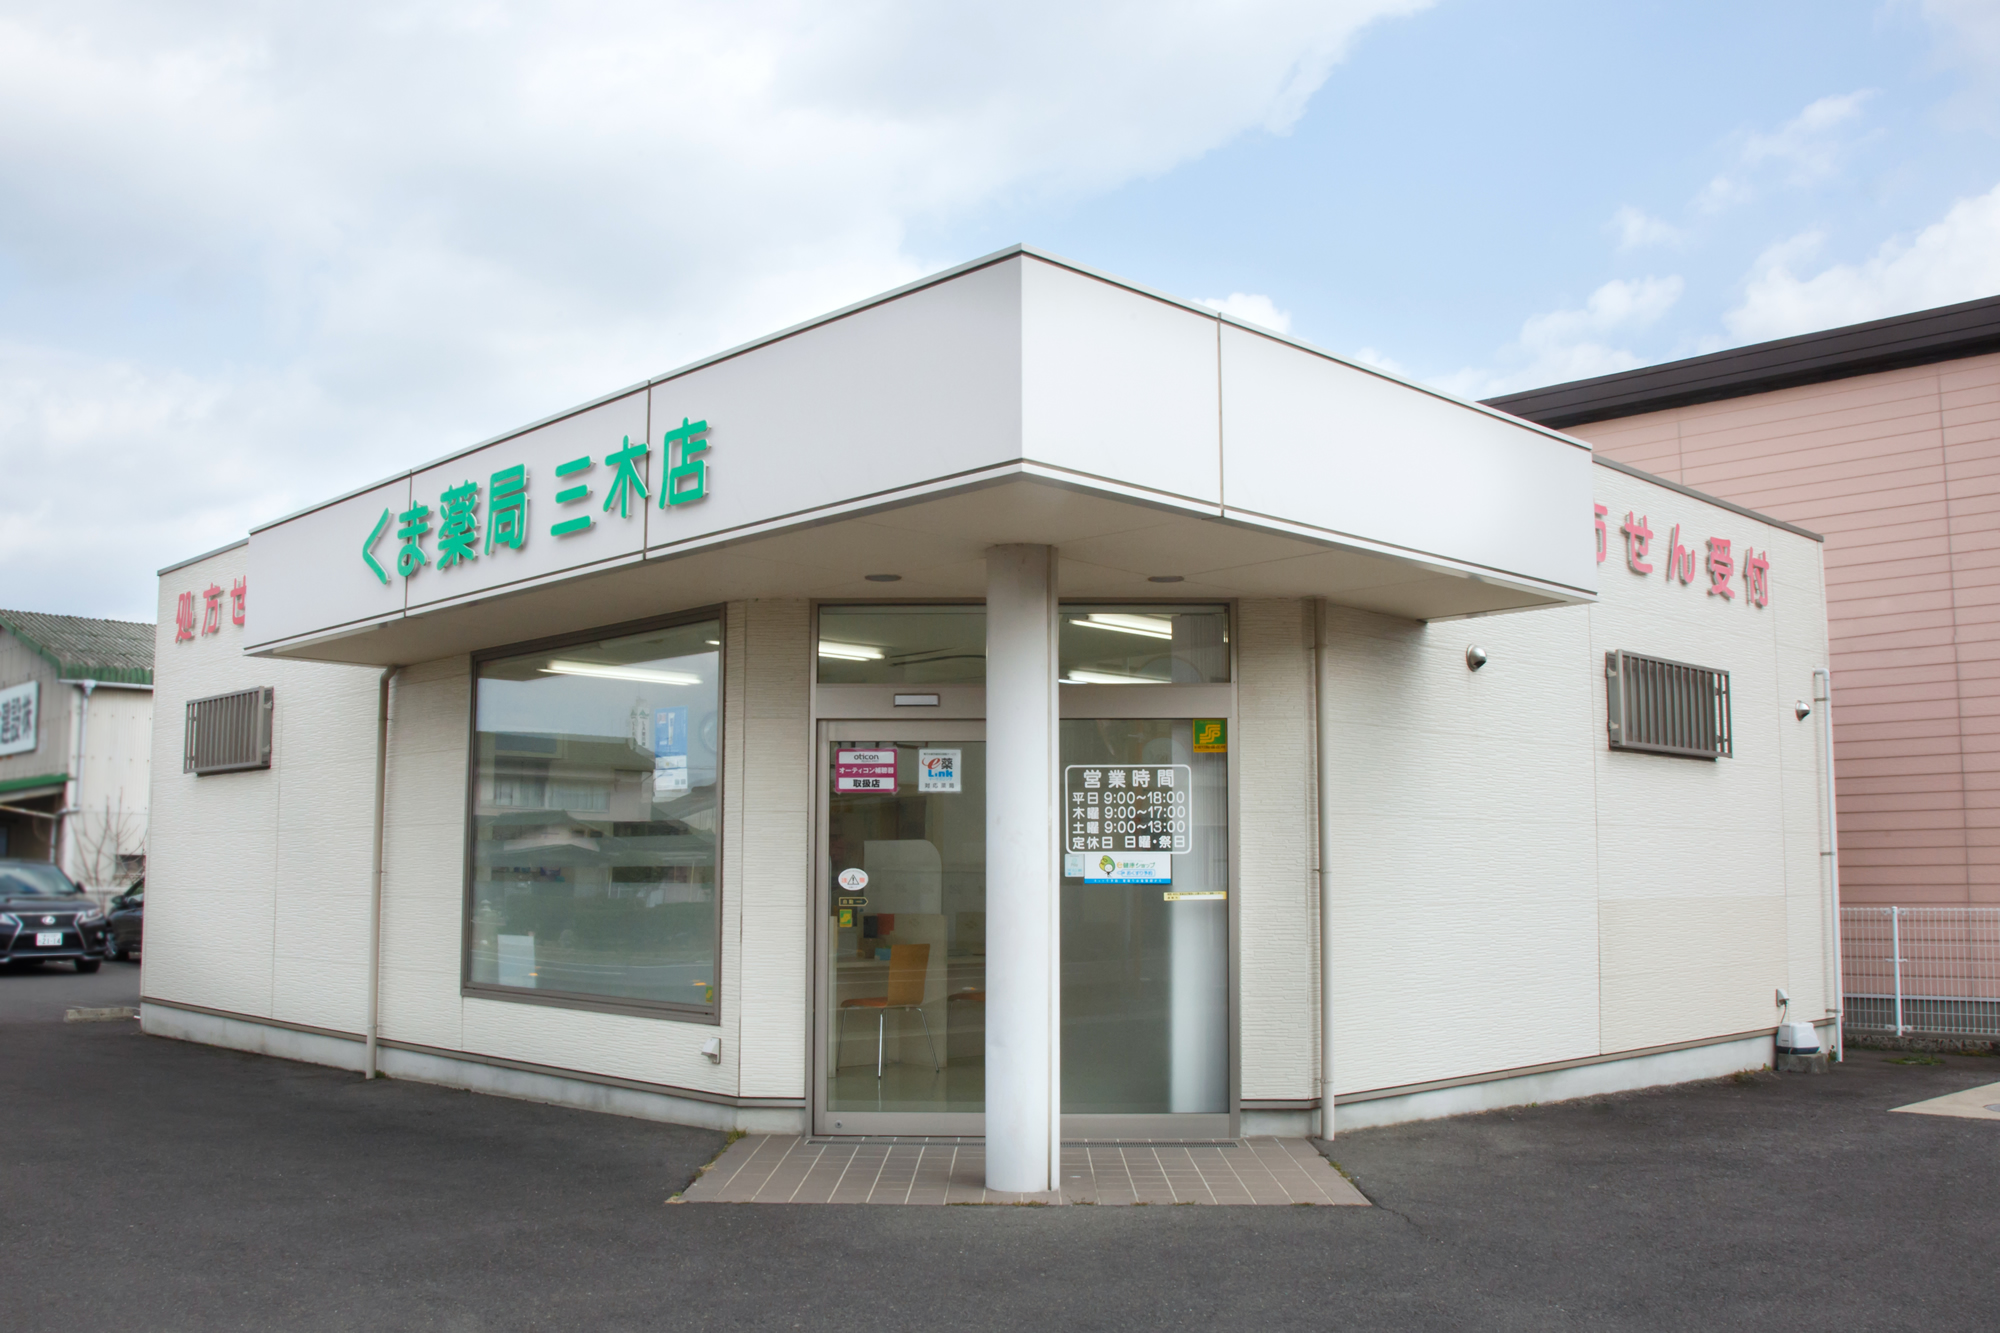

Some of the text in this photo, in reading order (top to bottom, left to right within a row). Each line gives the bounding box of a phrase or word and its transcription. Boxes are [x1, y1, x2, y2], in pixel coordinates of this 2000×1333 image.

[362, 417, 709, 585] くま薬局 三木店
[853, 779, 880, 788] 取扱店
[1083, 769, 1175, 788] 営業時間
[1072, 792, 1099, 804] 平日
[1072, 807, 1099, 819] 木曜
[1072, 821, 1099, 834] 土曜
[1072, 836, 1113, 850] 定休日
